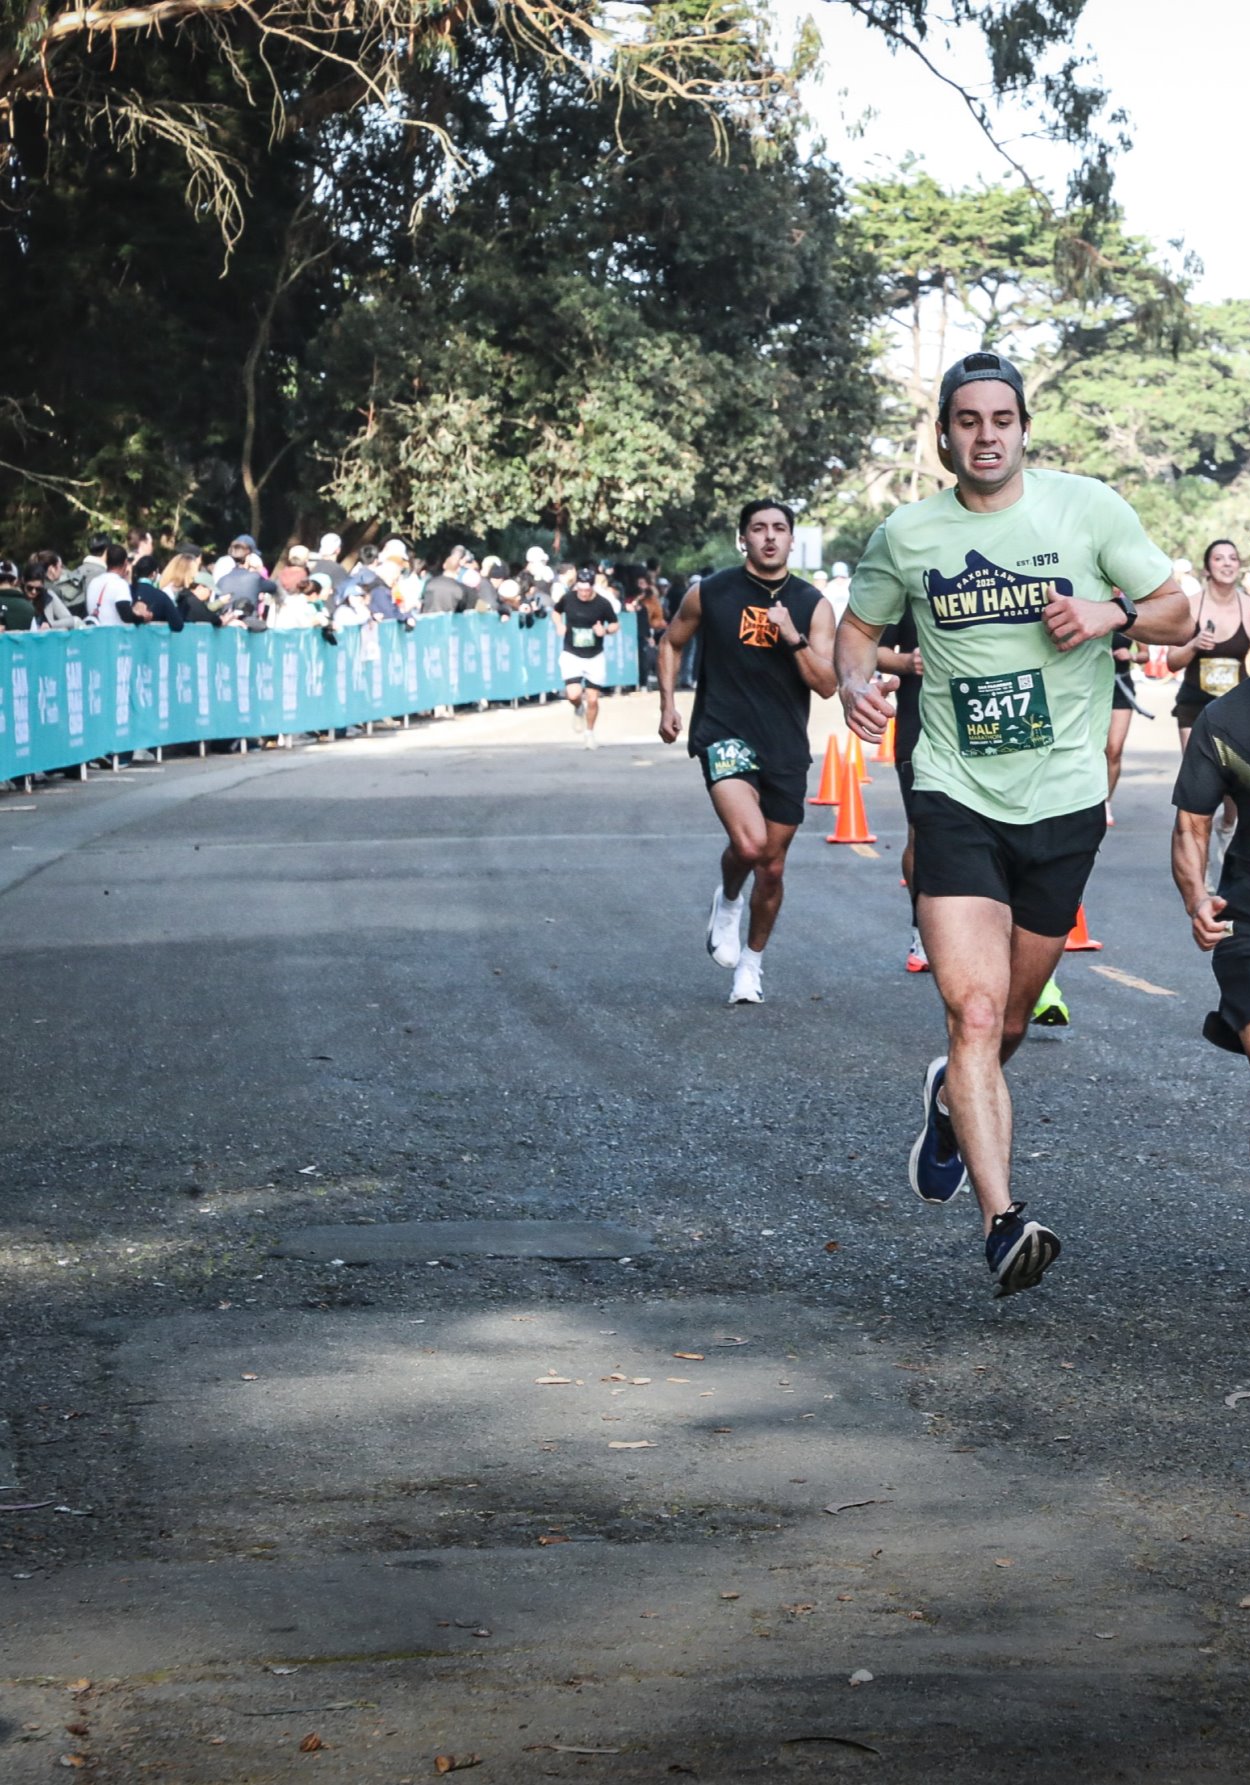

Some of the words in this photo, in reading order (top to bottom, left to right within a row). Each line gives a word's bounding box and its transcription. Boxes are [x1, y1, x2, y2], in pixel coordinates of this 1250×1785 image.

[1016, 559, 1032, 567] EST.
[1032, 552, 1059, 567] 1978
[956, 568, 989, 590] FAXON
[994, 569, 1016, 583] LAW
[975, 578, 996, 588] 2025
[933, 591, 977, 617] NEW
[1003, 609, 1029, 617] ROAD
[968, 692, 1031, 722] 3417
[967, 722, 1000, 735] HALF
